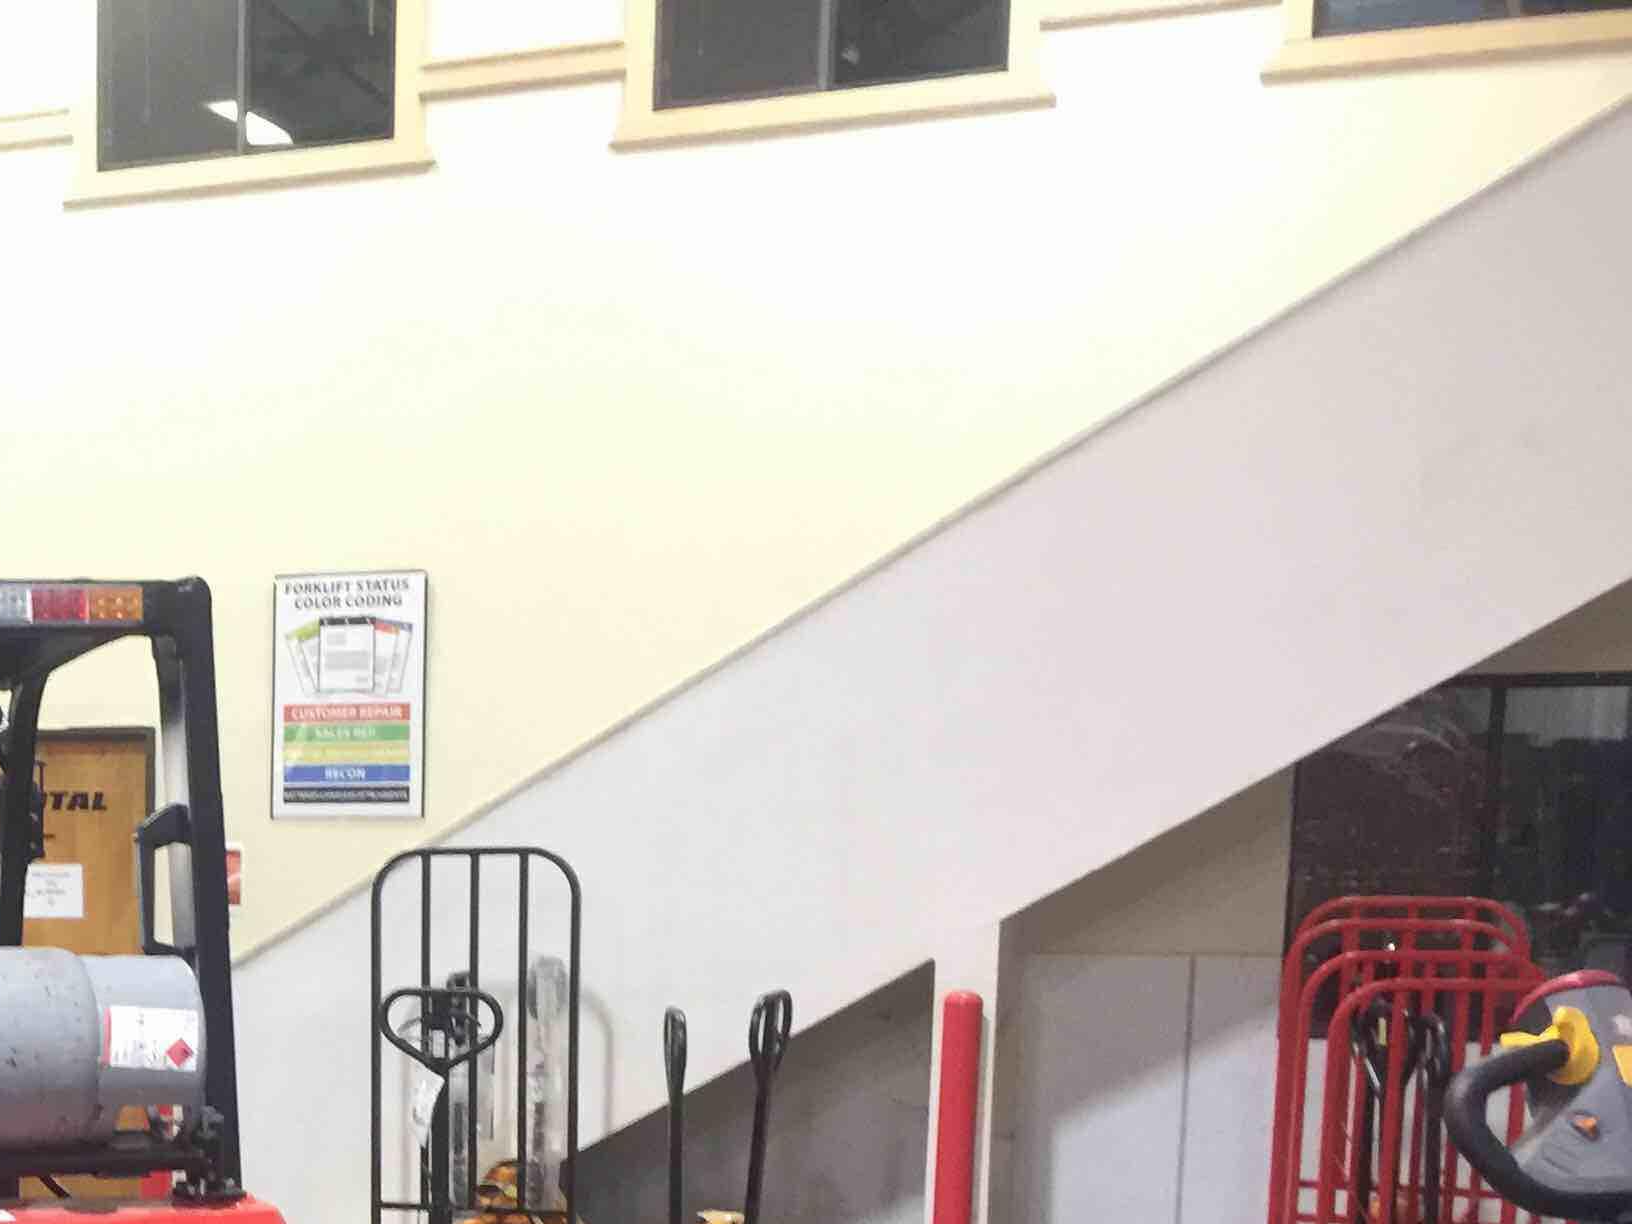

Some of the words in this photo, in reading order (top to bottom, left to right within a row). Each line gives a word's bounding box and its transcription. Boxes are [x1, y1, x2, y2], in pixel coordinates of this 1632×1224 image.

[284, 580, 350, 595] FORKLIFT
[355, 577, 410, 592] STATUS
[294, 596, 342, 610] COLOR
[344, 594, 403, 608] CODING
[291, 706, 357, 720] CUSTOMER
[43, 790, 108, 811] TAL
